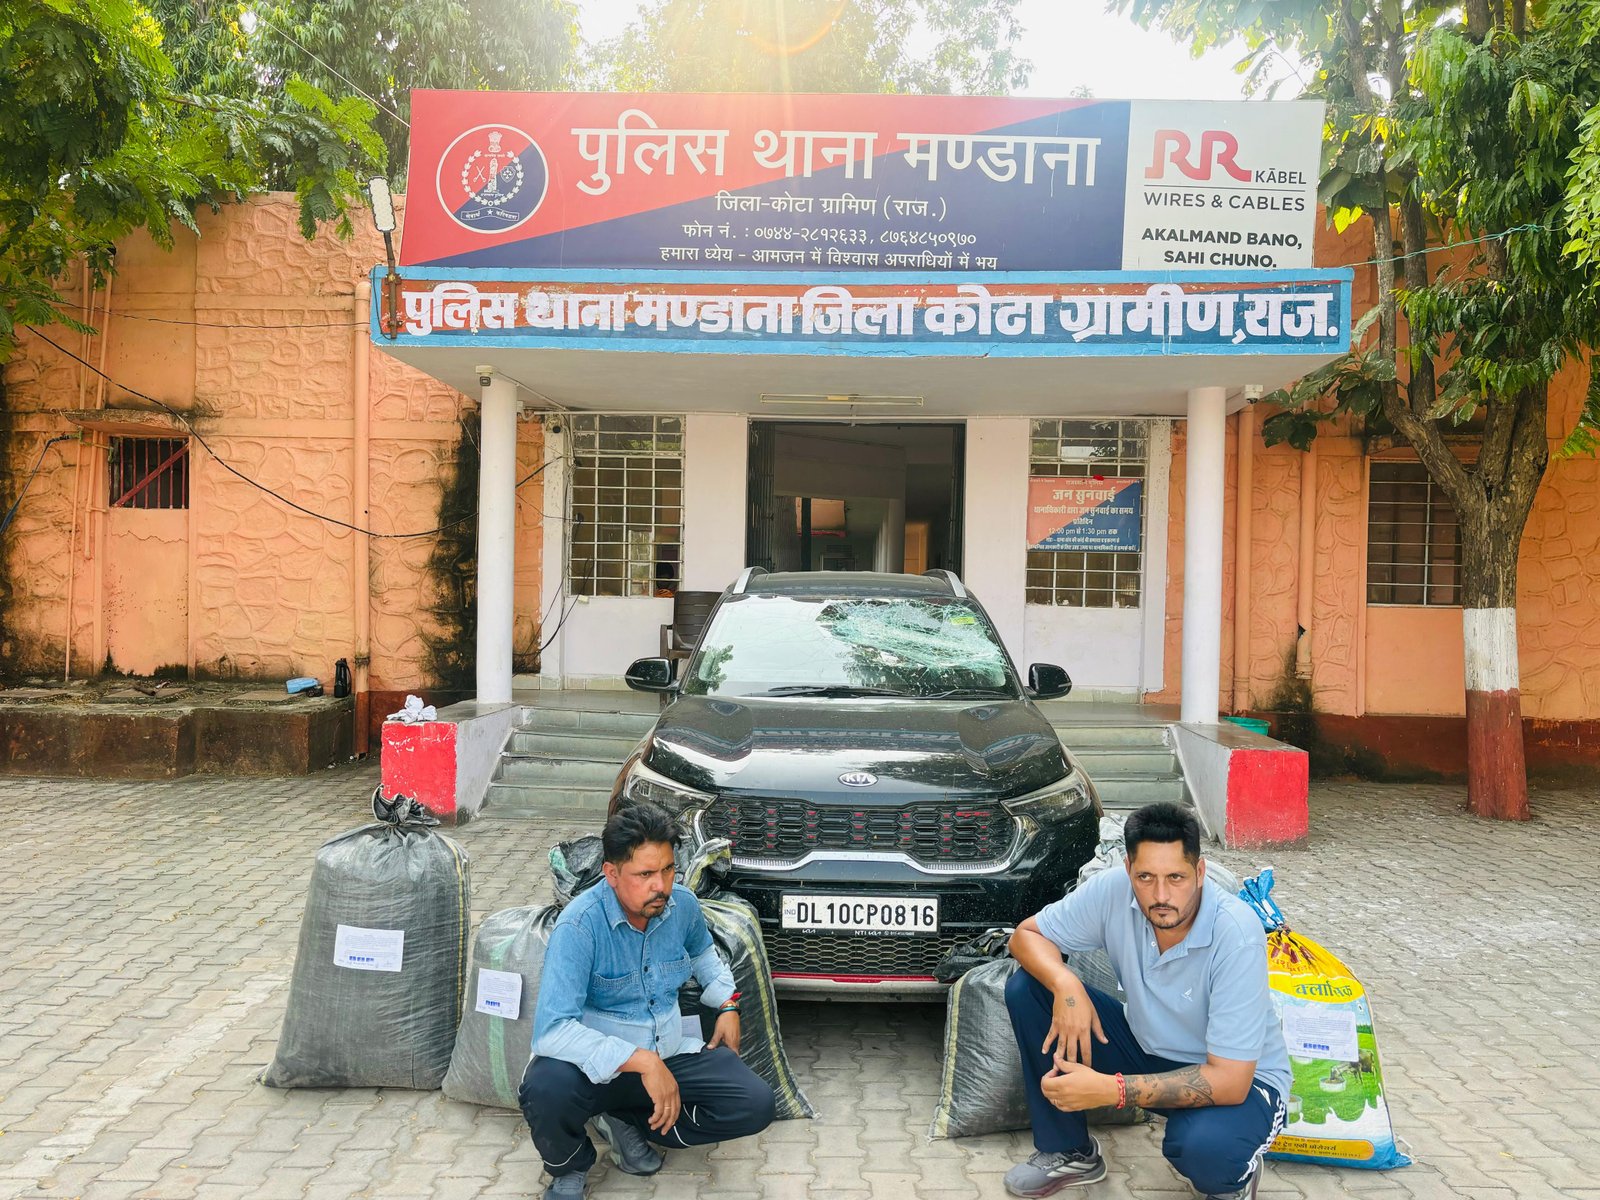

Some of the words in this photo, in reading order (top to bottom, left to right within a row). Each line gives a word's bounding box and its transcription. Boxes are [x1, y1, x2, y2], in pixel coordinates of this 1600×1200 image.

[571, 109, 730, 195] पुलिस
[753, 129, 878, 179] थाना
[896, 133, 1102, 187] मण्डाना
[1144, 129, 1252, 182] RR
[1255, 168, 1307, 185] KĀBEL
[715, 190, 813, 213] जिला-कोटा
[819, 192, 877, 216] ग्रामिण
[1144, 192, 1205, 208] WIRES
[1211, 195, 1223, 209] &
[1228, 195, 1305, 211] CABLES
[682, 220, 713, 238] फोन
[880, 230, 977, 247] ८७६४८५०९७०
[1142, 228, 1242, 244] AKALMAND
[1247, 232, 1303, 250] BANO,
[659, 247, 699, 262] हमारा
[704, 243, 733, 262] ध्येय
[752, 249, 805, 264] आमजन
[809, 246, 823, 265] में
[826, 246, 879, 266] विश्वास
[884, 249, 953, 269] अपराधियों
[957, 252, 970, 270] में
[975, 256, 998, 270] भय
[1164, 250, 1205, 265] SAHI
[1209, 252, 1277, 268] CHUNO.
[402, 282, 519, 336] पुलिस
[526, 291, 625, 332] थाना
[631, 293, 799, 334] मण्डाना
[799, 285, 919, 336] जिला
[924, 284, 1054, 336] कोटा
[1053, 489, 1072, 500] जन
[1075, 486, 1116, 505] सुनवाई
[1082, 527, 1095, 535] 1:30
[797, 902, 934, 926] DL10CP0816
